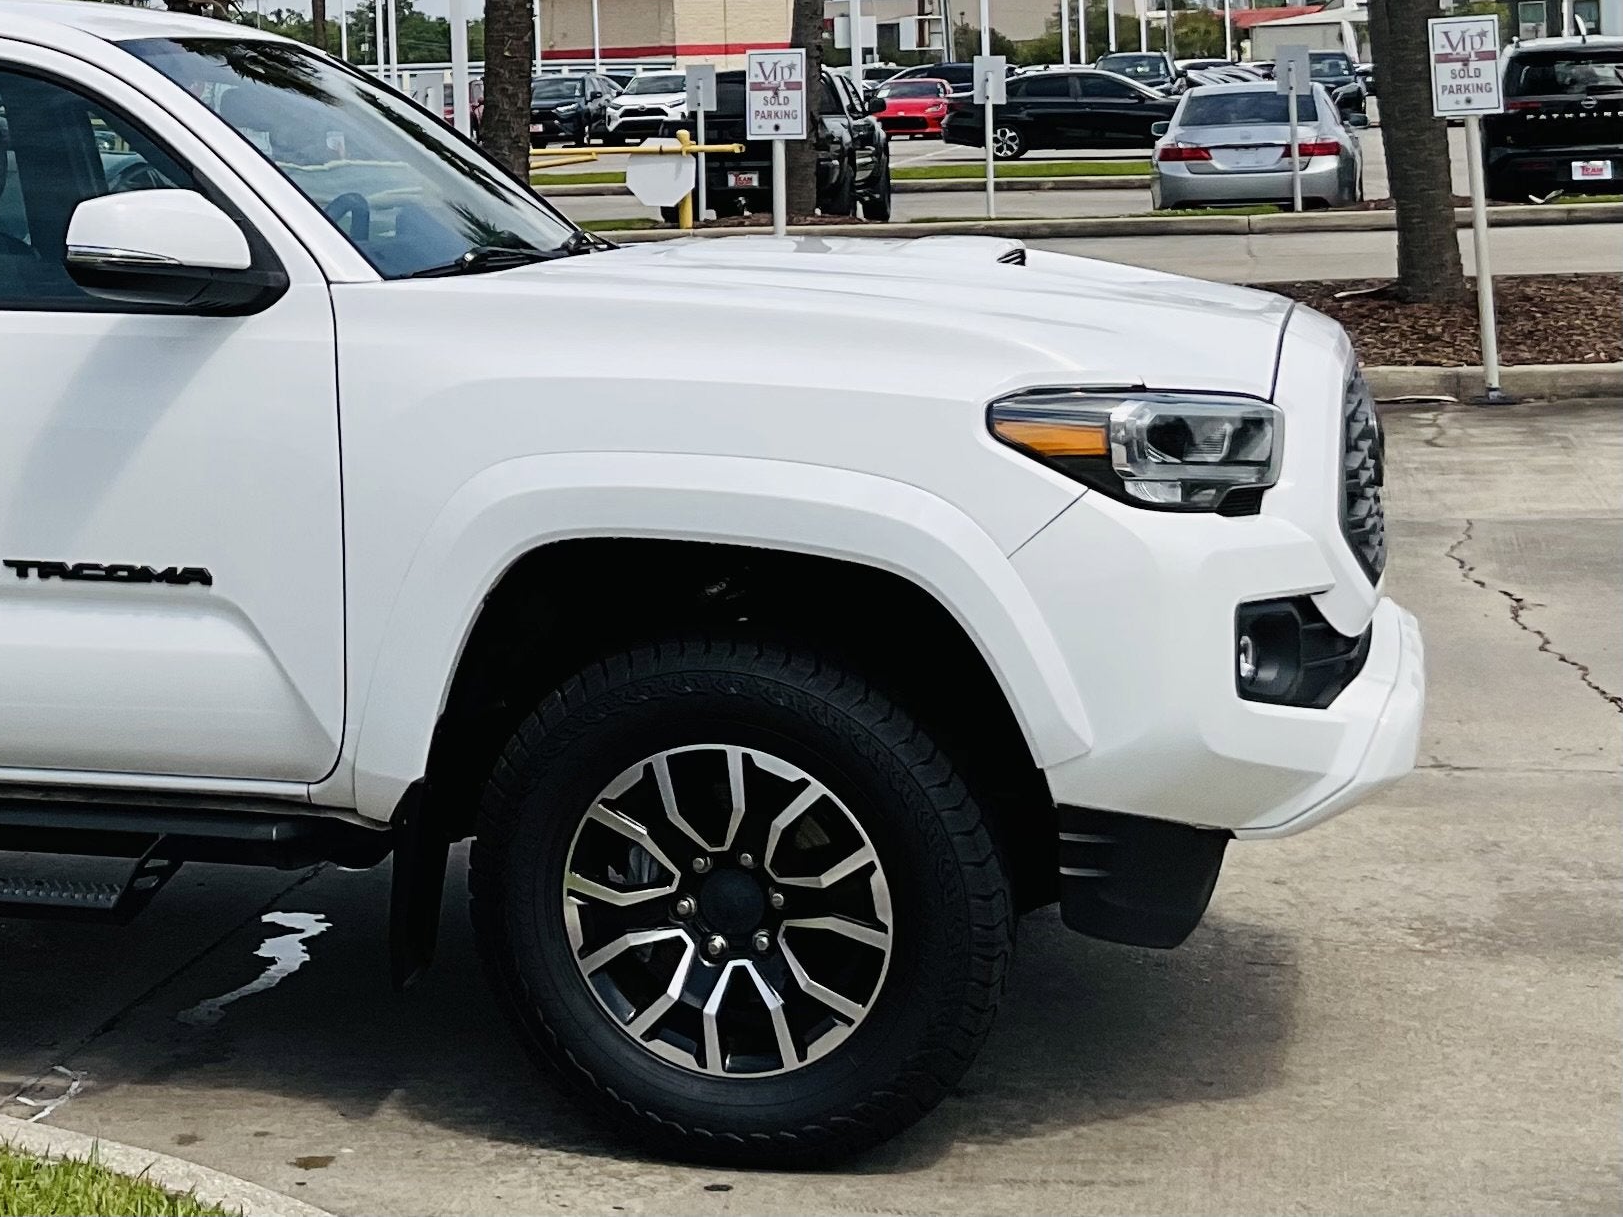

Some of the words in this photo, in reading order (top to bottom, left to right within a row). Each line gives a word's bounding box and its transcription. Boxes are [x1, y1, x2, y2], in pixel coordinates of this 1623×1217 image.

[1450, 68, 1481, 80] SOLD
[1441, 83, 1493, 95] PARKING
[763, 95, 790, 106] SOLD
[754, 109, 798, 120] PARKING
[2, 559, 213, 586] TACOMA
